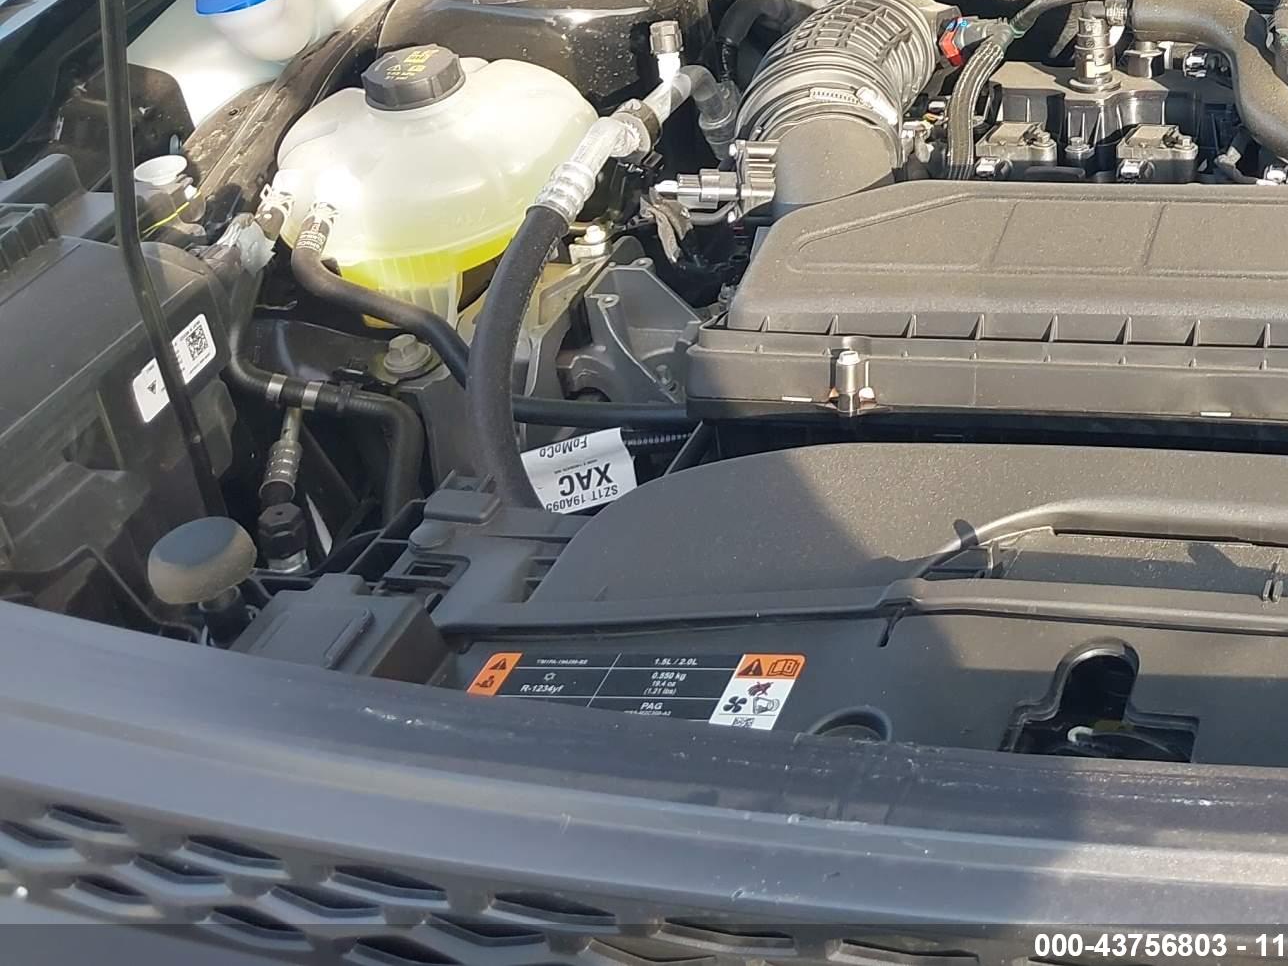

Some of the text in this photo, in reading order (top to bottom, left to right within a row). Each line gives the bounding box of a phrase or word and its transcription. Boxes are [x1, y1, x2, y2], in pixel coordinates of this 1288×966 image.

[539, 436, 588, 459] FoMoCo
[558, 463, 614, 497] XAC
[591, 484, 619, 501] SZ1T
[654, 657, 672, 666] 1.5L
[678, 658, 698, 666] 2.0L
[675, 672, 687, 681] kg
[520, 684, 564, 694] R-1234yf
[640, 702, 663, 710] PAG
